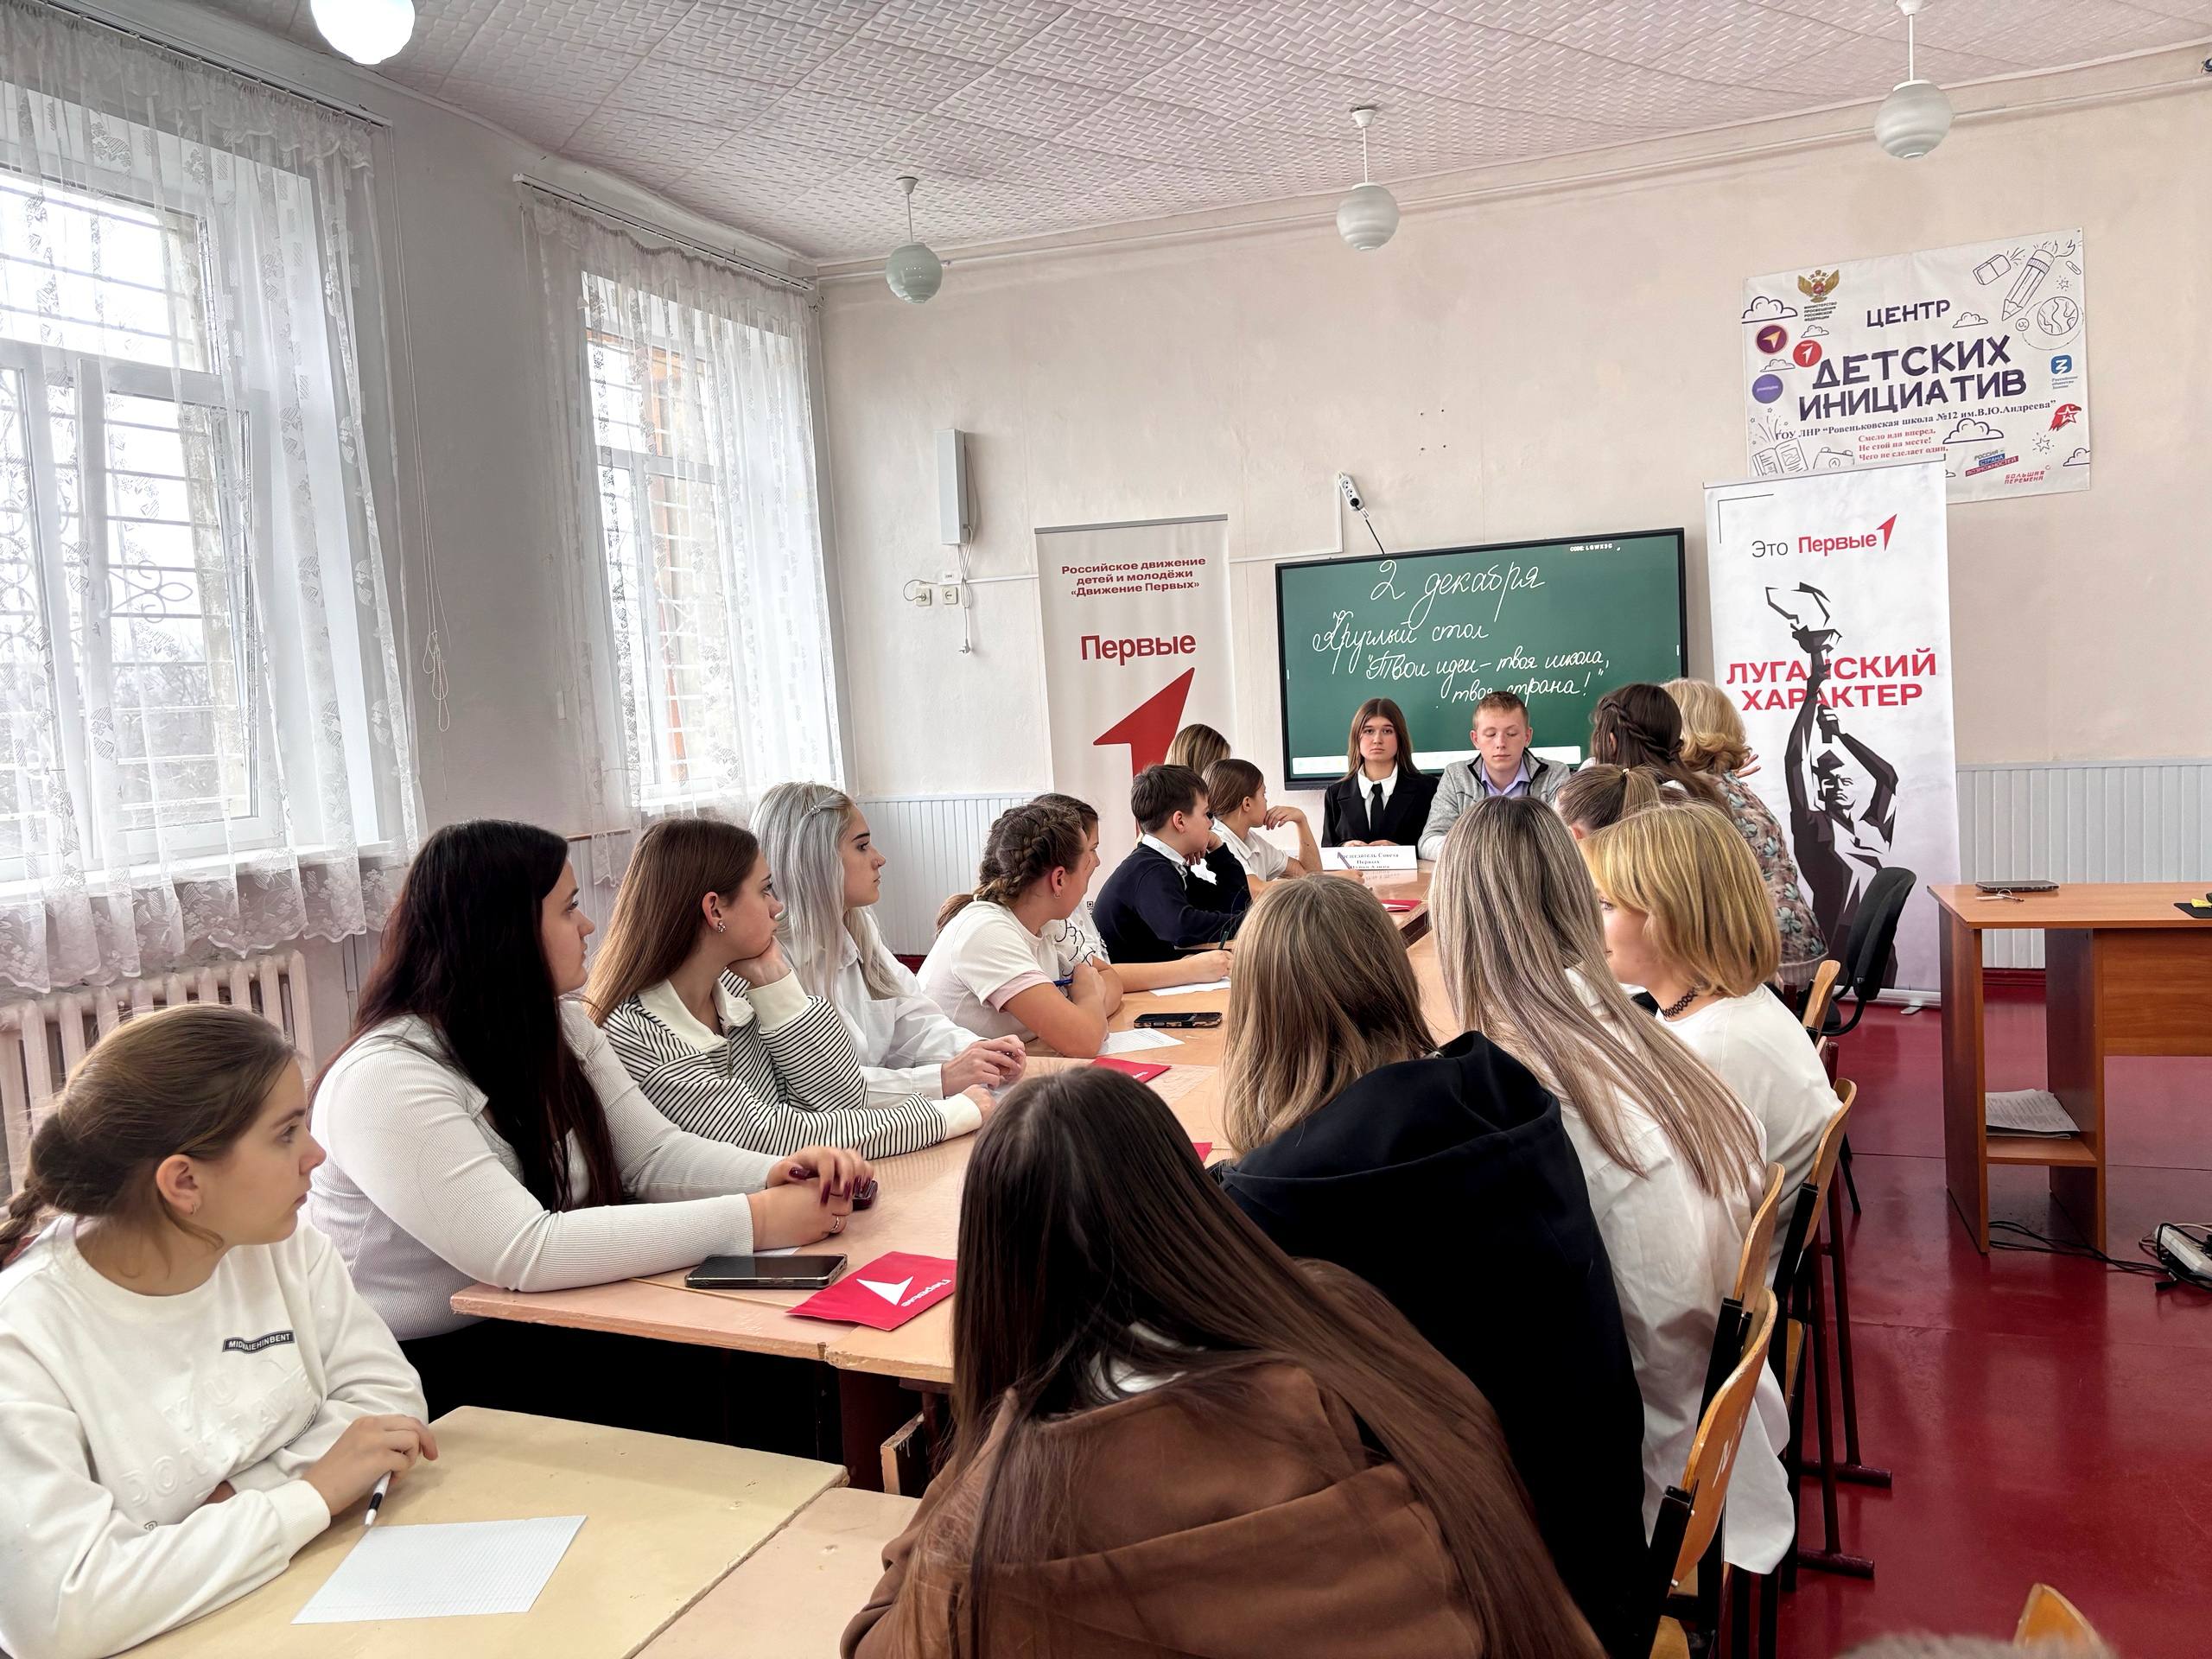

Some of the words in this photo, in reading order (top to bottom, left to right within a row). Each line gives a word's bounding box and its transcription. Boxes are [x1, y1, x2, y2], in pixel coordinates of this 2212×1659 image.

[1866, 299, 1951, 327] ЦЕНТР
[1812, 334, 2012, 390] ДЕТСКИХ
[1799, 369, 2027, 422] ИНИЦИАТИВ
[1776, 429, 1796, 441] ГОУ
[1798, 428, 1821, 438] ЛНР
[1902, 416, 1934, 425] школа
[1936, 411, 1958, 423] №12
[1859, 434, 1885, 442] Смело
[1872, 442, 1891, 450] стой
[1904, 436, 1932, 446] месте!
[1892, 448, 1923, 457] сделает
[1980, 455, 2004, 466] СТРАНА
[1751, 540, 1789, 558] Это
[1798, 533, 1878, 556] Первые
[1062, 563, 1139, 574] Российское
[1141, 558, 1206, 570] движение
[1077, 574, 1114, 586] детей
[1127, 569, 1193, 582] молодёжи
[1071, 584, 1142, 597] «Движение
[1145, 581, 1199, 592] Первых»
[1370, 560, 1406, 601] 2
[1401, 562, 1545, 630] декабря
[1081, 634, 1196, 666] Первые
[1313, 610, 1417, 674] Круглый
[1432, 623, 1490, 642] стол
[1496, 645, 1538, 672] твоя
